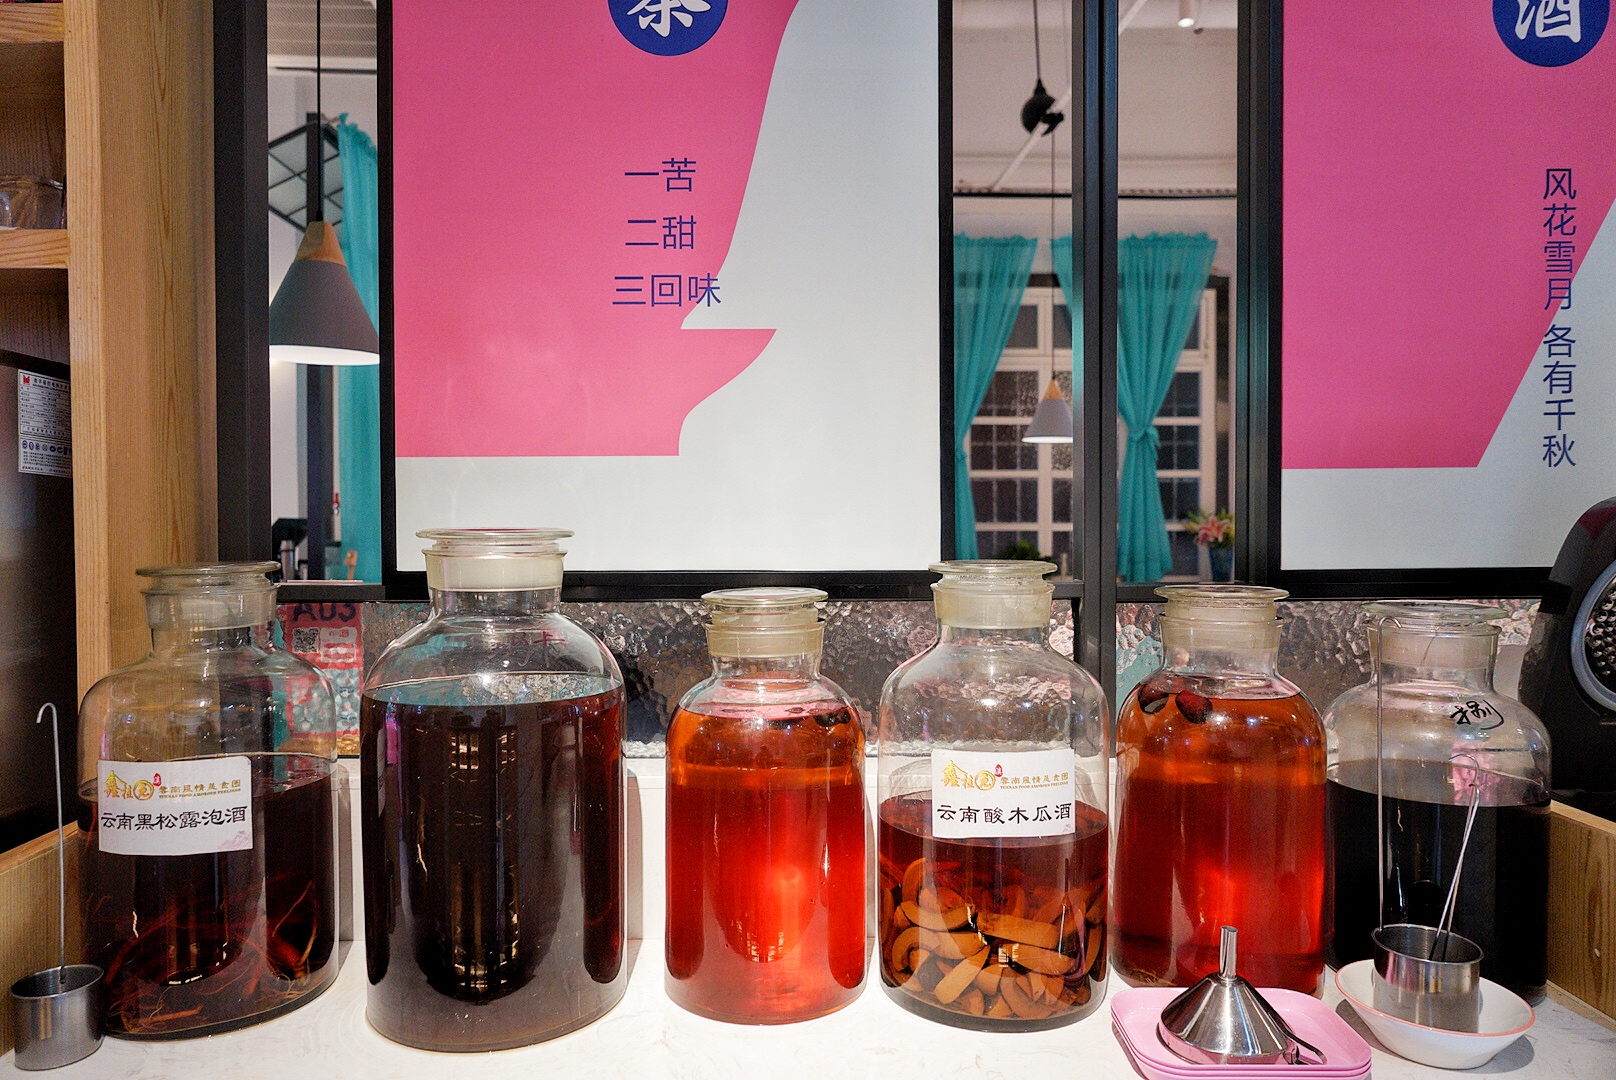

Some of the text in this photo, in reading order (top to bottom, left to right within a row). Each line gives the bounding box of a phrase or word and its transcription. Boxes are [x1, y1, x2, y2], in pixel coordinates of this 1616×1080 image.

[1515, 0, 1582, 43] 酒
[624, 157, 697, 192] 一苦
[625, 215, 697, 250] 二甜
[612, 272, 722, 307] 三回味
[1542, 168, 1577, 468] 风花雪月 各有千秋
[101, 805, 248, 830] 云南黑松露泡酒
[937, 803, 1072, 825] 云南酸木瓜酒
